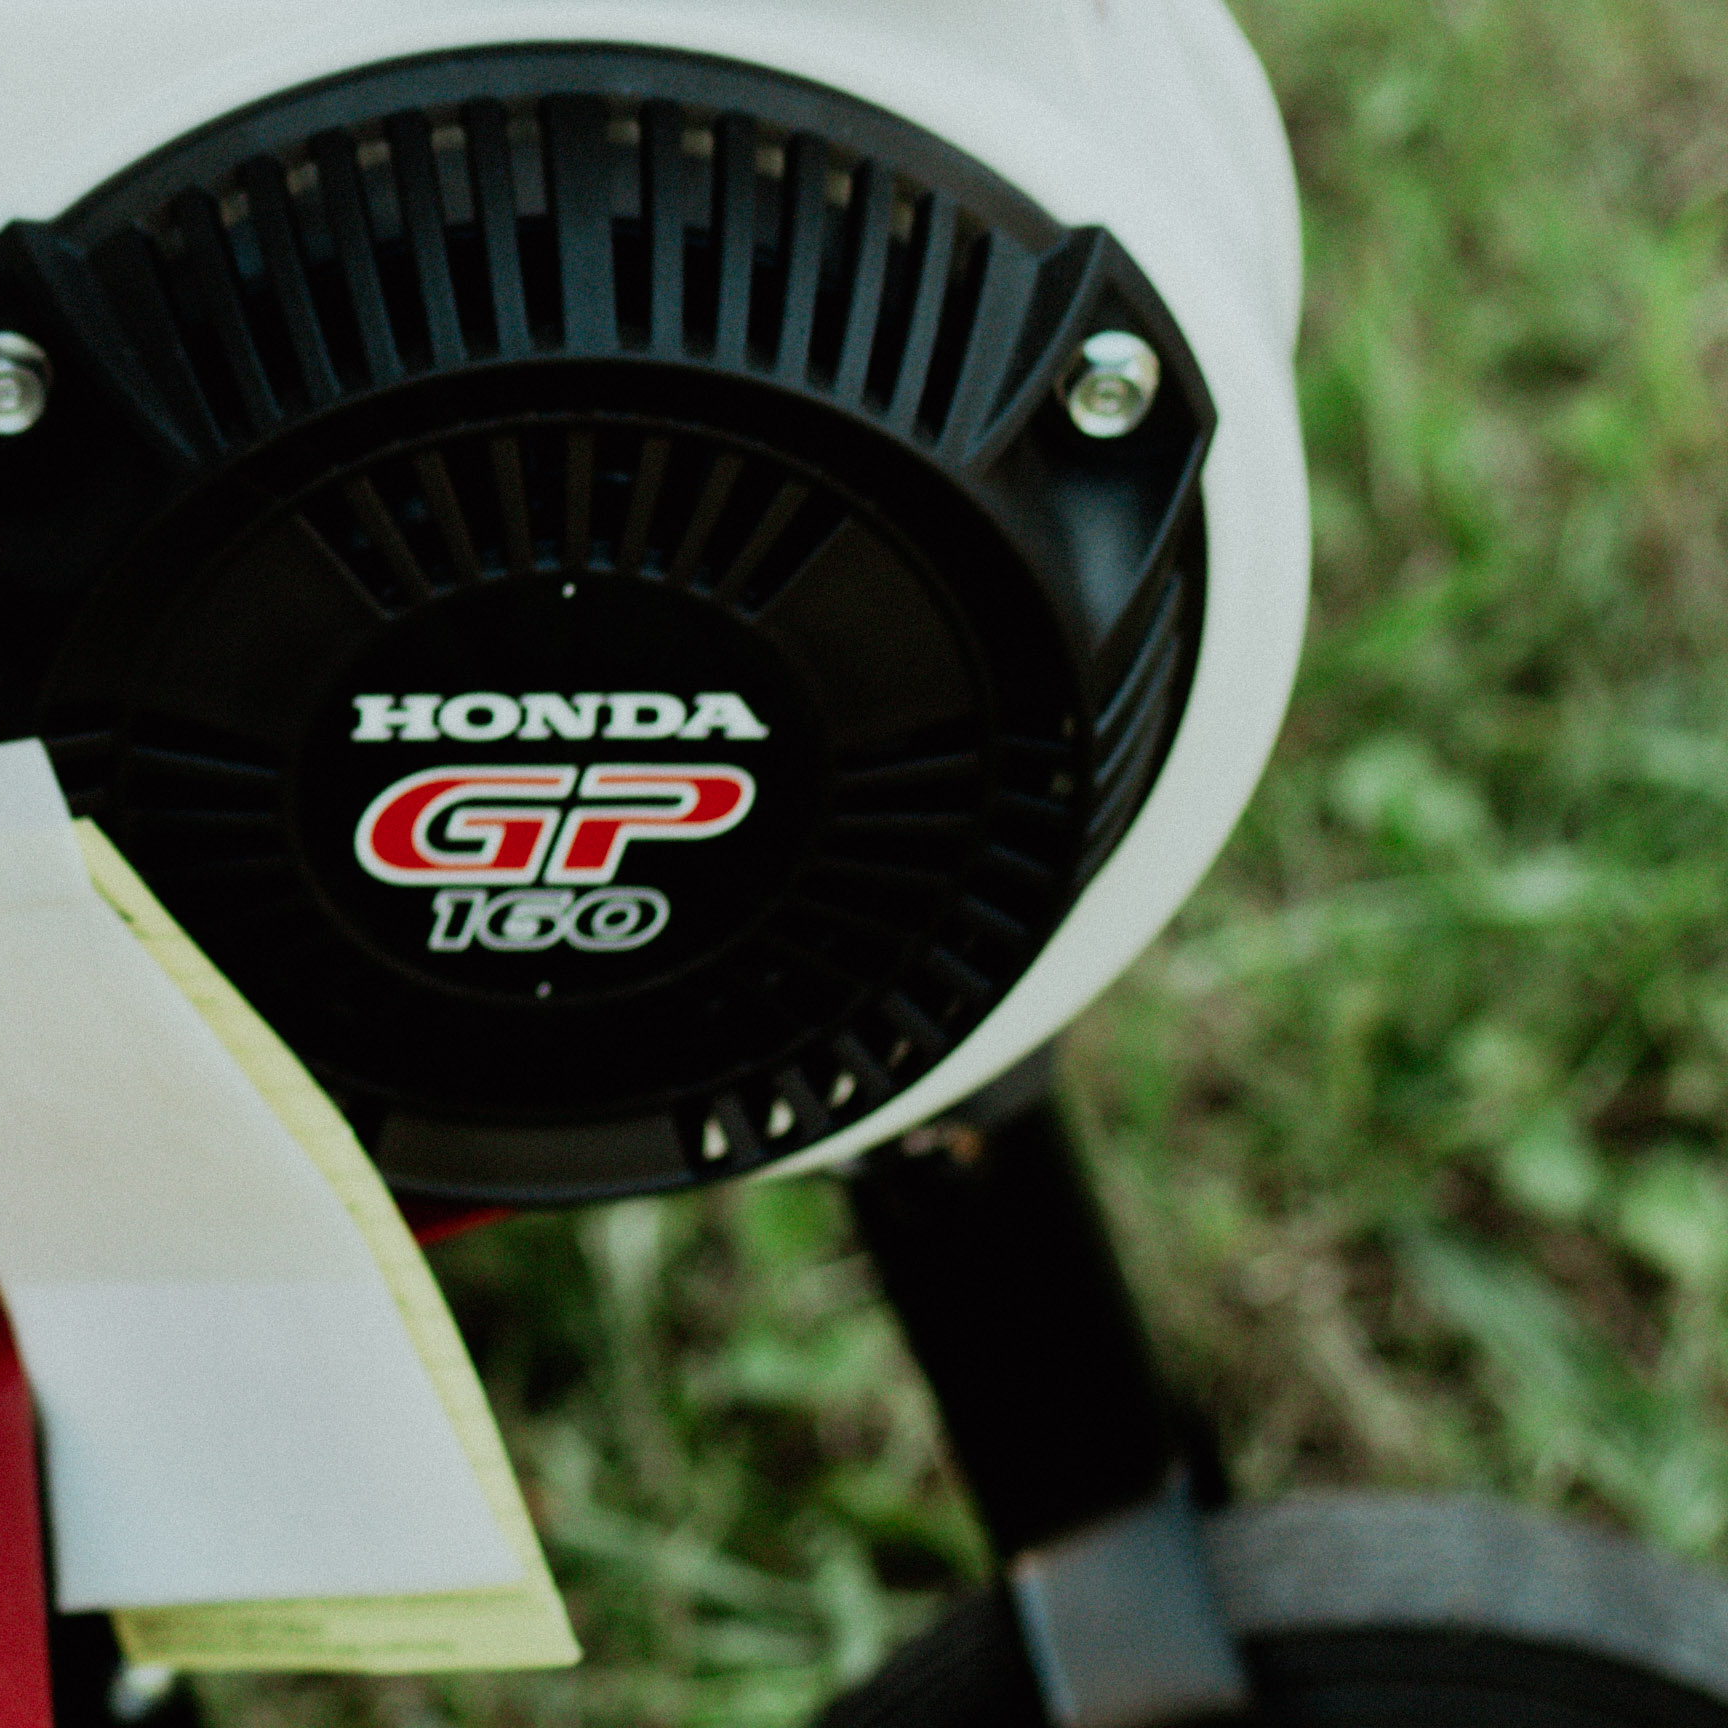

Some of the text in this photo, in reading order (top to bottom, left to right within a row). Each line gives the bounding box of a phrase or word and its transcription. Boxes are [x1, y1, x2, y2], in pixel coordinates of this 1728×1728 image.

[351, 692, 770, 742] HONDA
[354, 763, 757, 887] GP
[427, 886, 671, 953] 160
